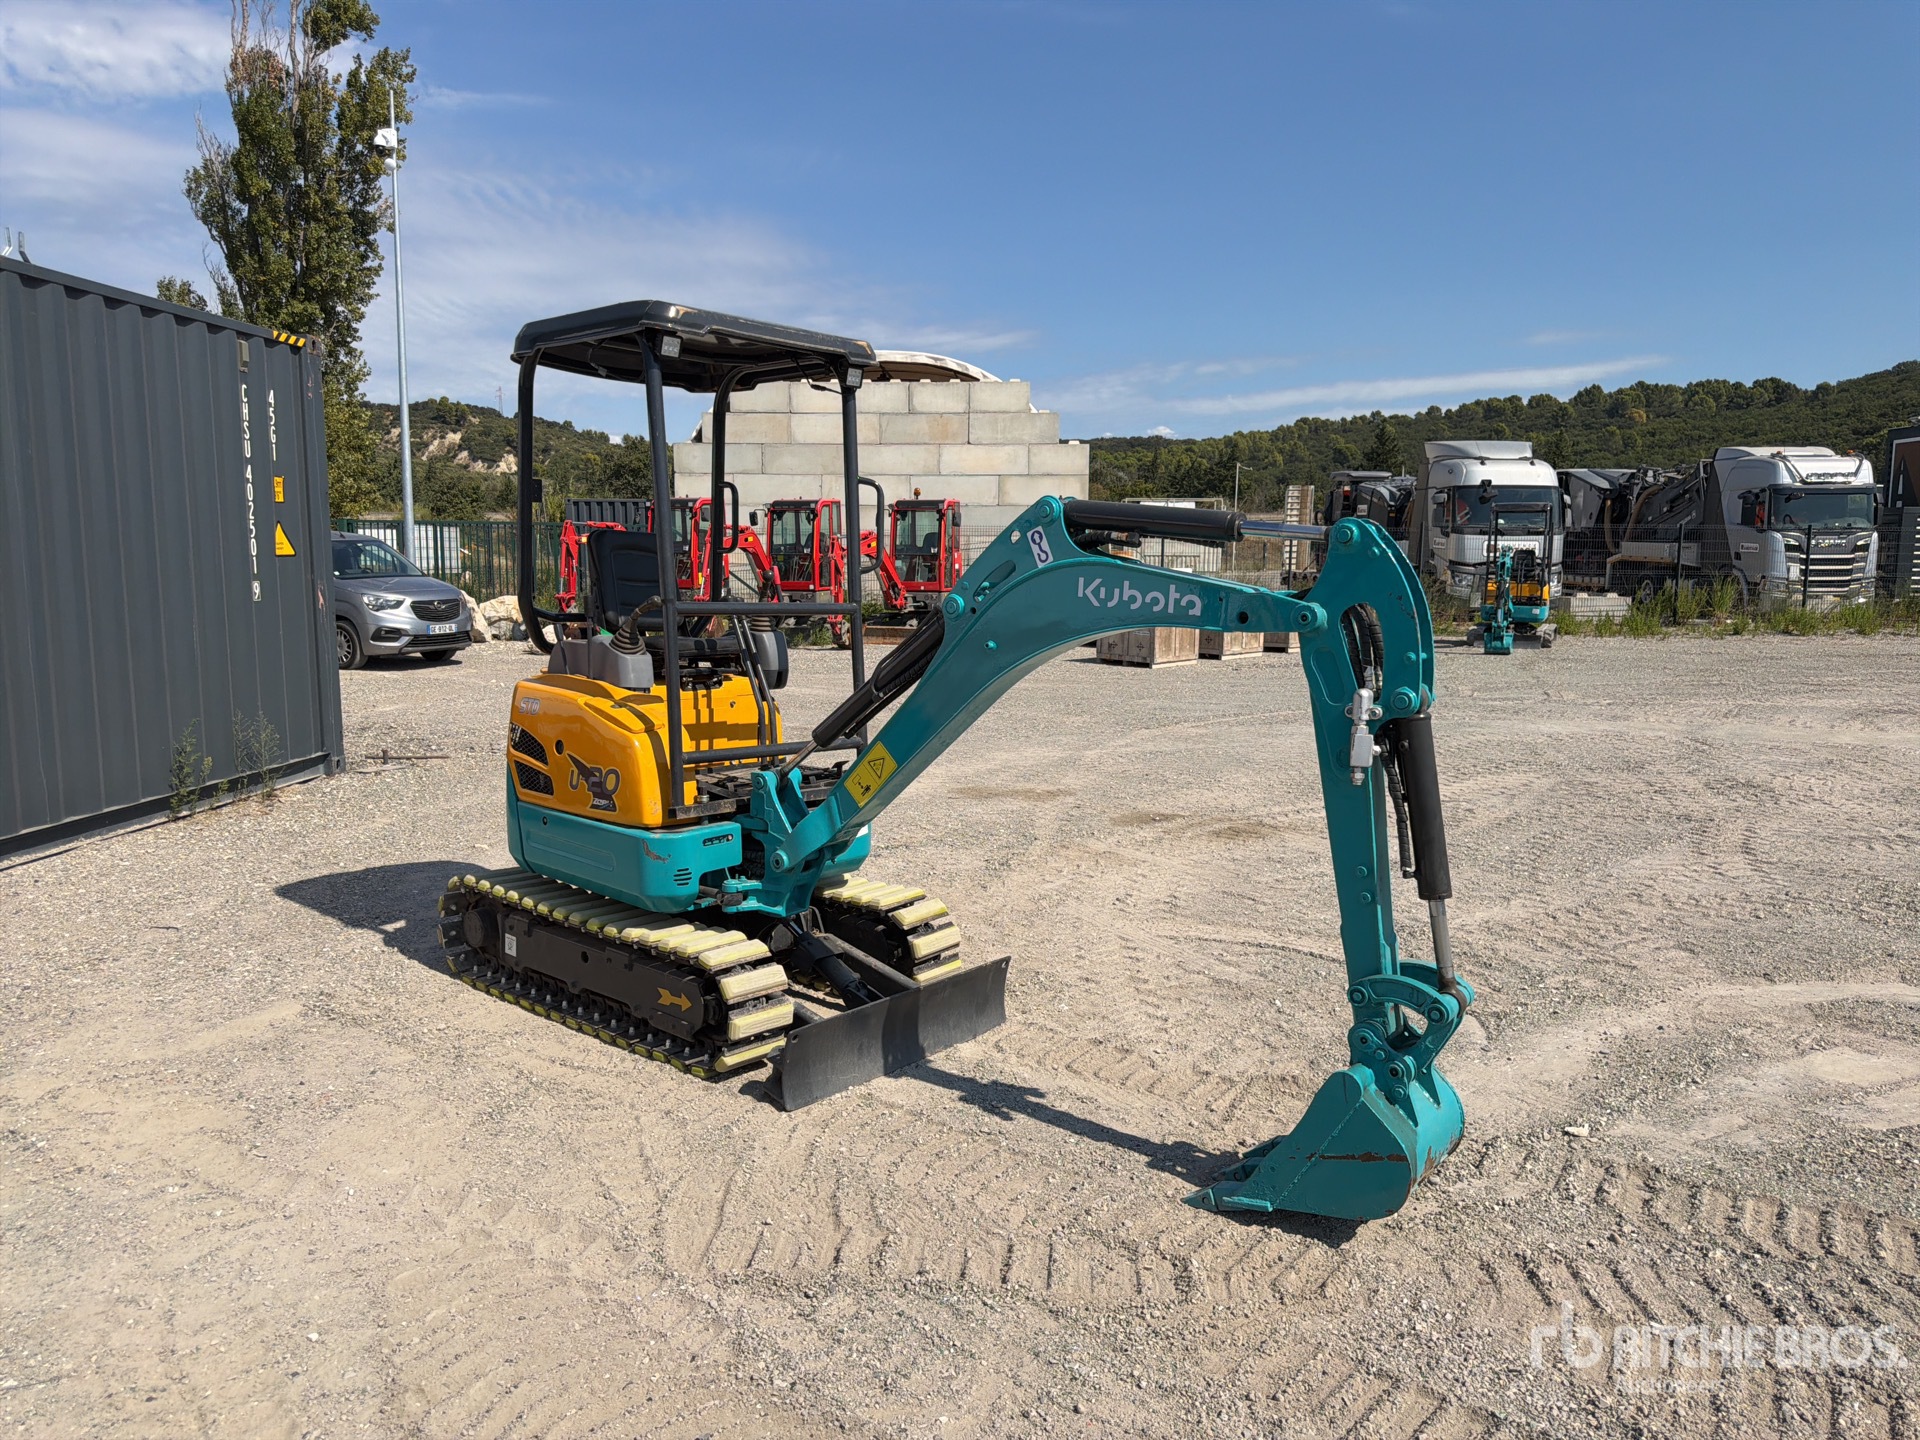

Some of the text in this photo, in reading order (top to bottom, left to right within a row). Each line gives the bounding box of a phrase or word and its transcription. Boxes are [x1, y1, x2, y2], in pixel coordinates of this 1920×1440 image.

[268, 389, 277, 461] 45G1
[241, 384, 261, 600] CHSU 402501 9
[1077, 577, 1202, 616] Kubota
[519, 697, 541, 715] STD
